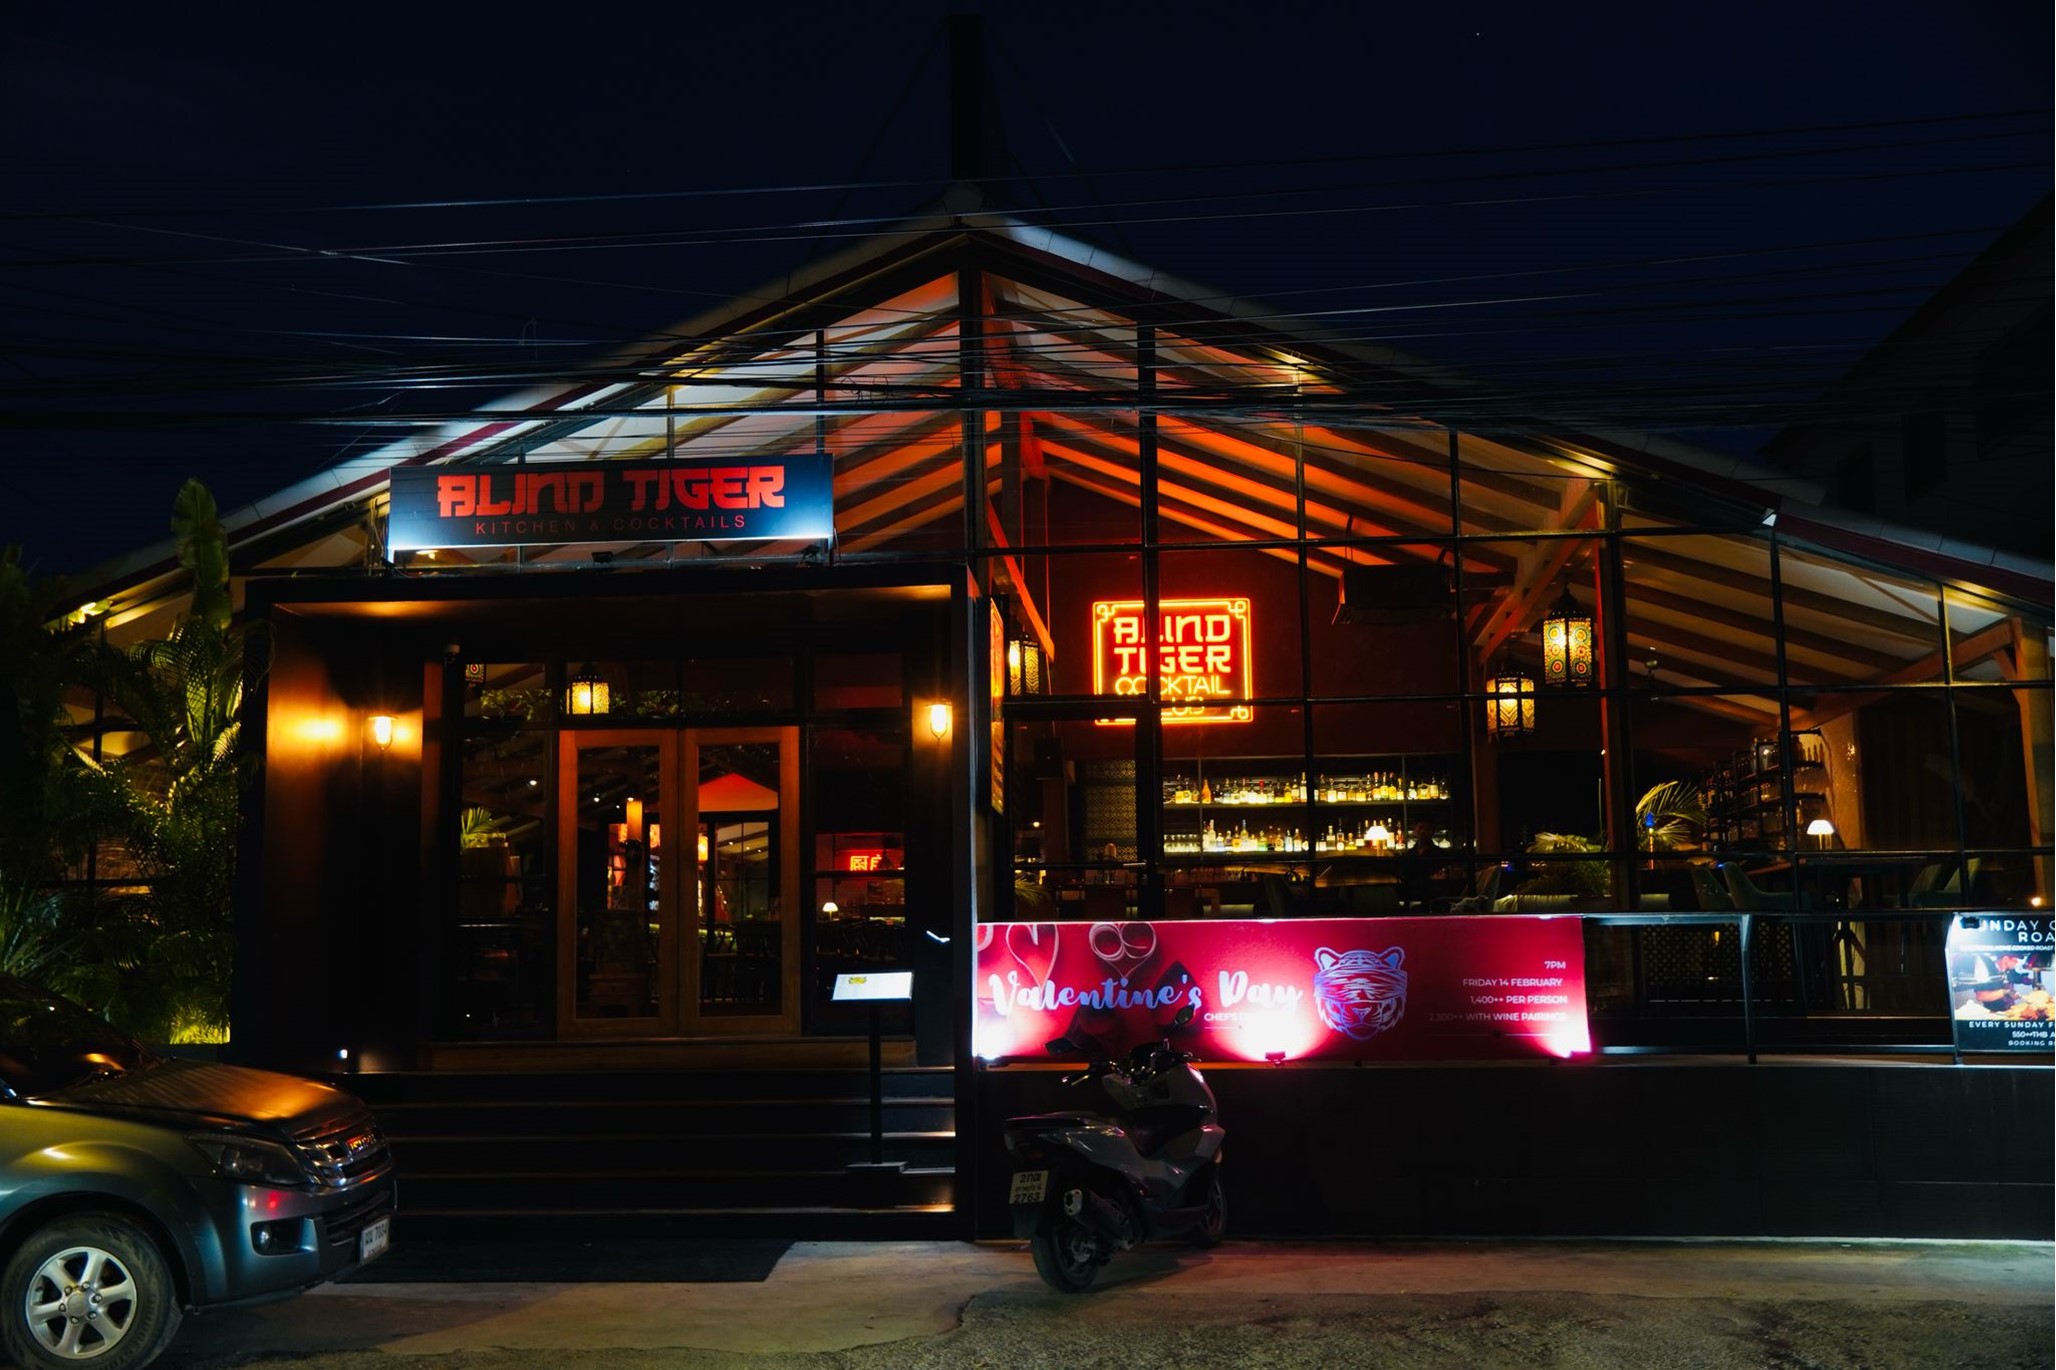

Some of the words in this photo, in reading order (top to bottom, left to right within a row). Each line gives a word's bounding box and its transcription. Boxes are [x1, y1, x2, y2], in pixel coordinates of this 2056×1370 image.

[437, 472, 604, 517] BLIND
[623, 465, 785, 511] TIGER
[475, 520, 576, 535] KITCHEN
[590, 520, 600, 532] &
[613, 515, 745, 531] COCKTAILS
[1980, 920, 2039, 931] UNDAY
[1544, 961, 1566, 969] 7PM
[1462, 978, 1497, 986] FRIDAY
[1499, 978, 1509, 986] 14
[1511, 978, 1563, 987] FEBRUARY
[988, 970, 1202, 1015] Valentine's
[1218, 970, 1304, 1011] Day
[1506, 995, 1526, 1004] PER
[1528, 995, 1568, 1004] PERSON
[1466, 1013, 1491, 1021] WITH
[1493, 1013, 1519, 1021] WINE
